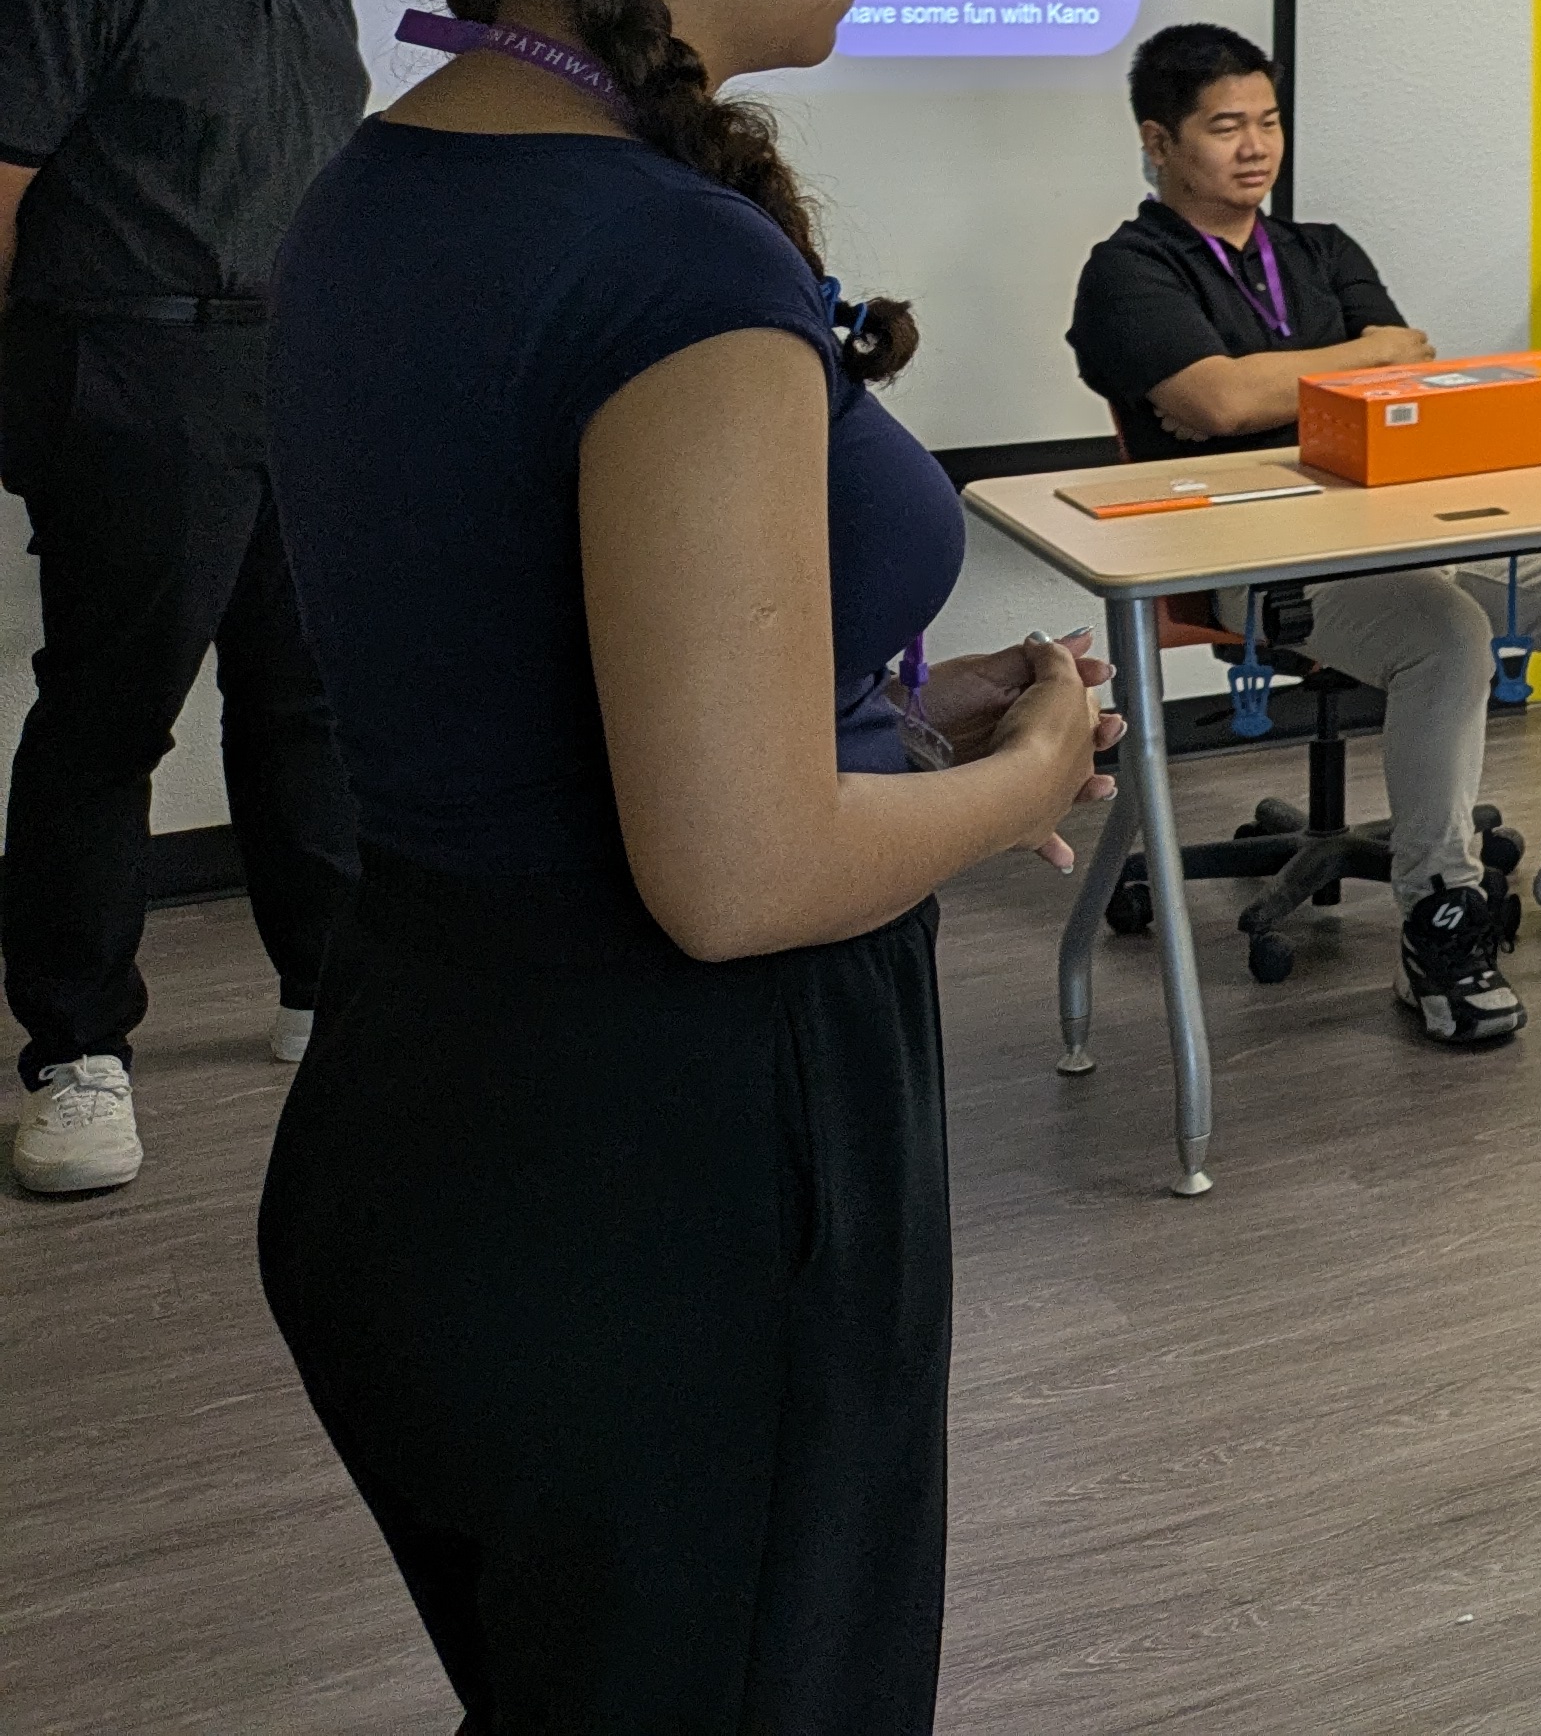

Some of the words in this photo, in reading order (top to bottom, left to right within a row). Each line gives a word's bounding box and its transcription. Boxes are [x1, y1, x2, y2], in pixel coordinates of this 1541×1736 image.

[901, 6, 959, 24] some
[963, 2, 996, 24] fun
[1000, 3, 1042, 24] with
[1047, 3, 1100, 24] Kano
